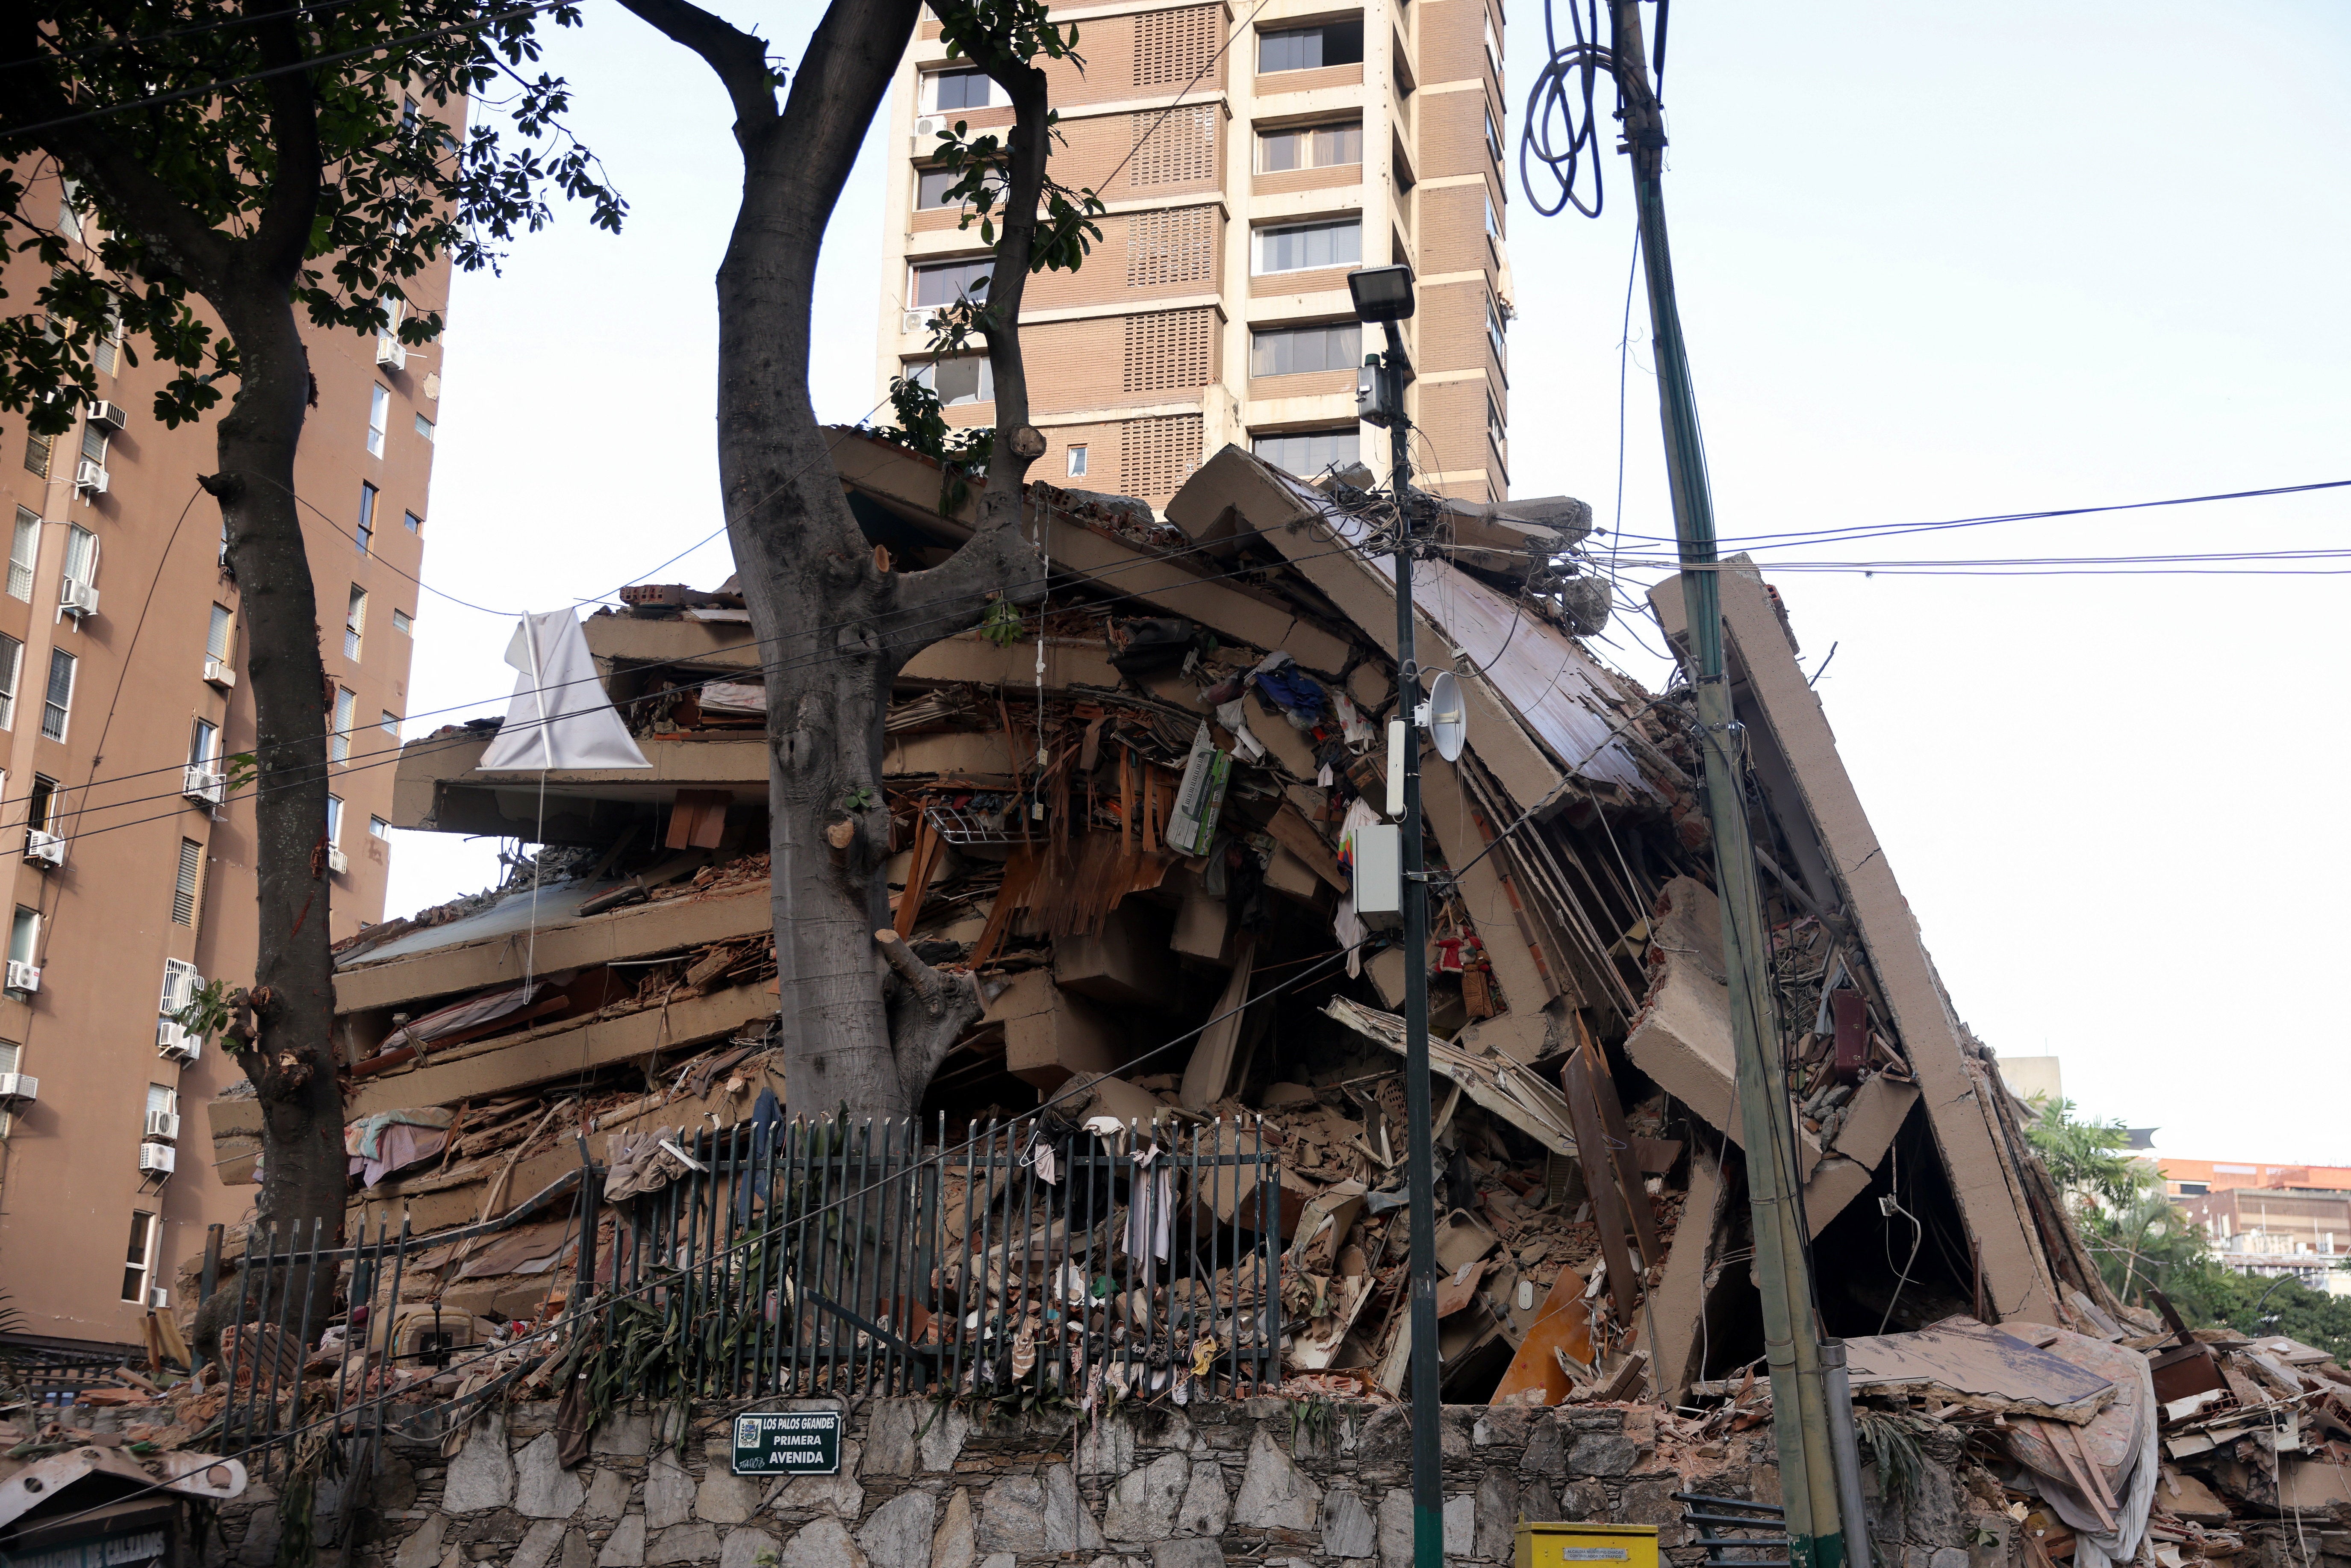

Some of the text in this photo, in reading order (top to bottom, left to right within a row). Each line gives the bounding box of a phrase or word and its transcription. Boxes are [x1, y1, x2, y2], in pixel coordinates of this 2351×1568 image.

[763, 1417, 834, 1430] LOS PALOS GRANDES
[774, 1435, 821, 1445] PRIMERA
[769, 1451, 824, 1463] AVENIDA
[106, 1530, 165, 1566] CALZADOS
